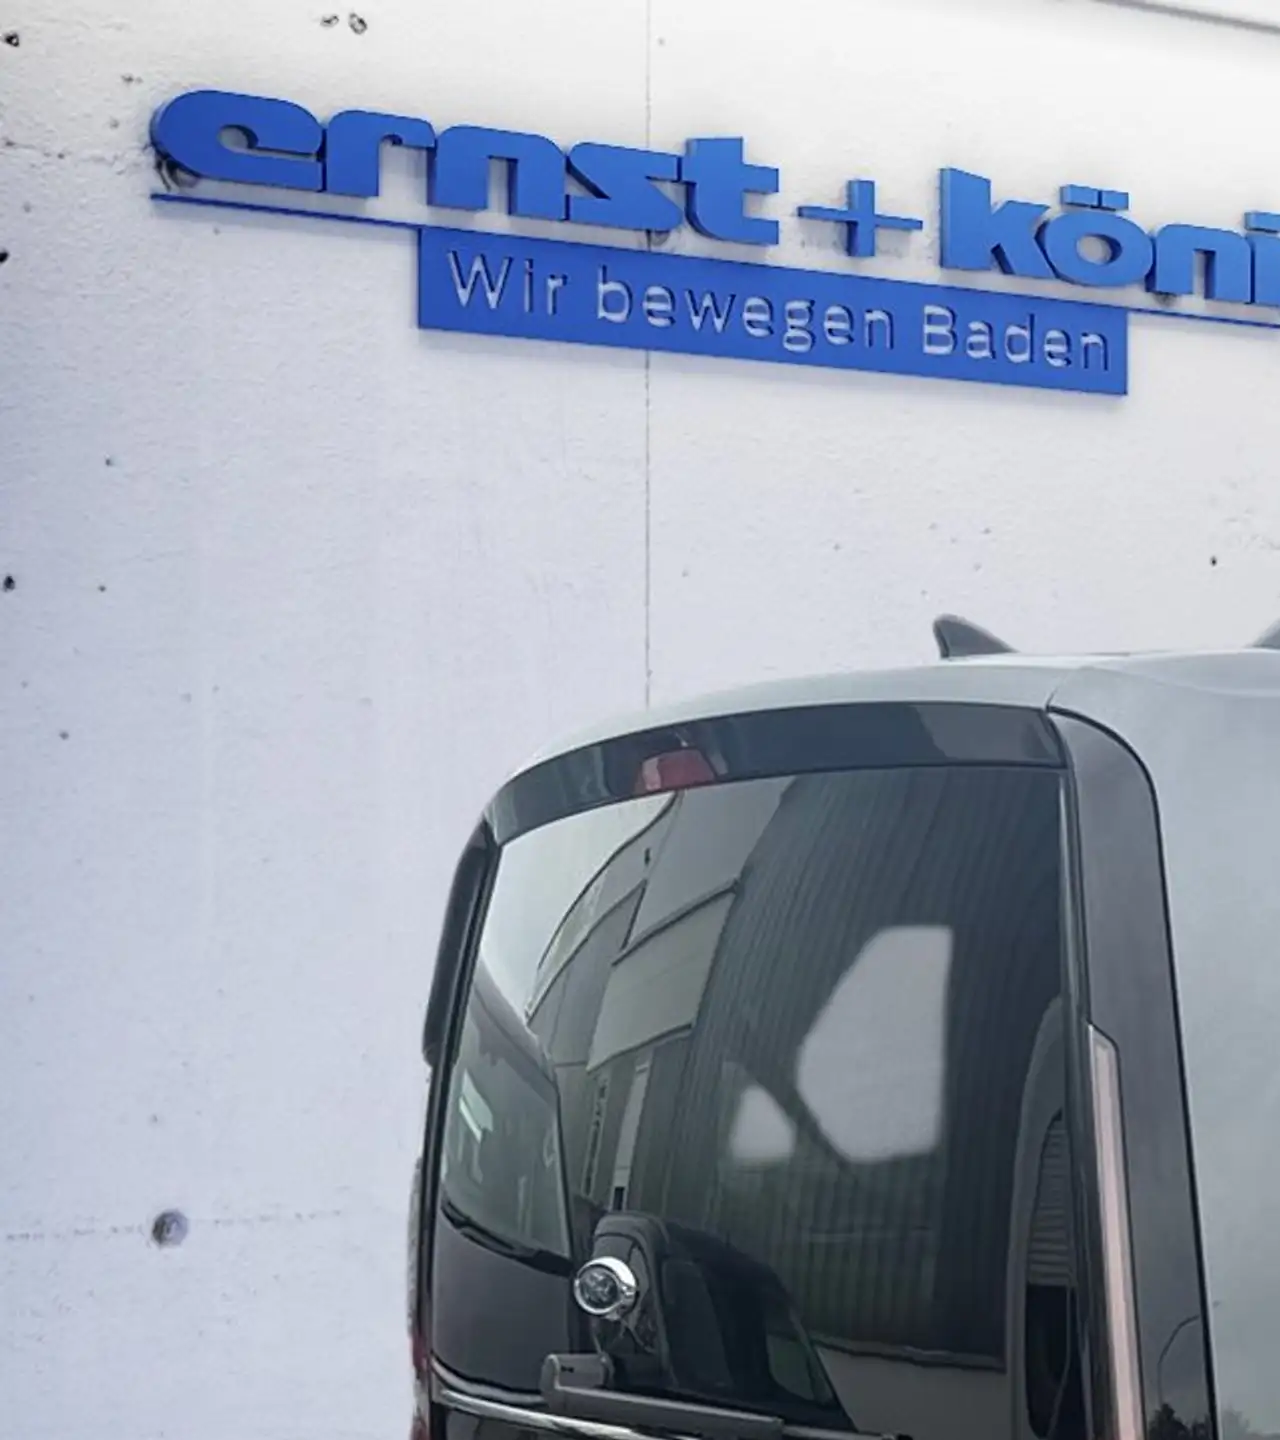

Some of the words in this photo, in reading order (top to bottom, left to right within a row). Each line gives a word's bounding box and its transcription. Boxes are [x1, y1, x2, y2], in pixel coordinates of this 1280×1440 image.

[447, 249, 568, 316] Wir
[597, 264, 896, 353] bewegen
[922, 304, 1112, 372] Baden
